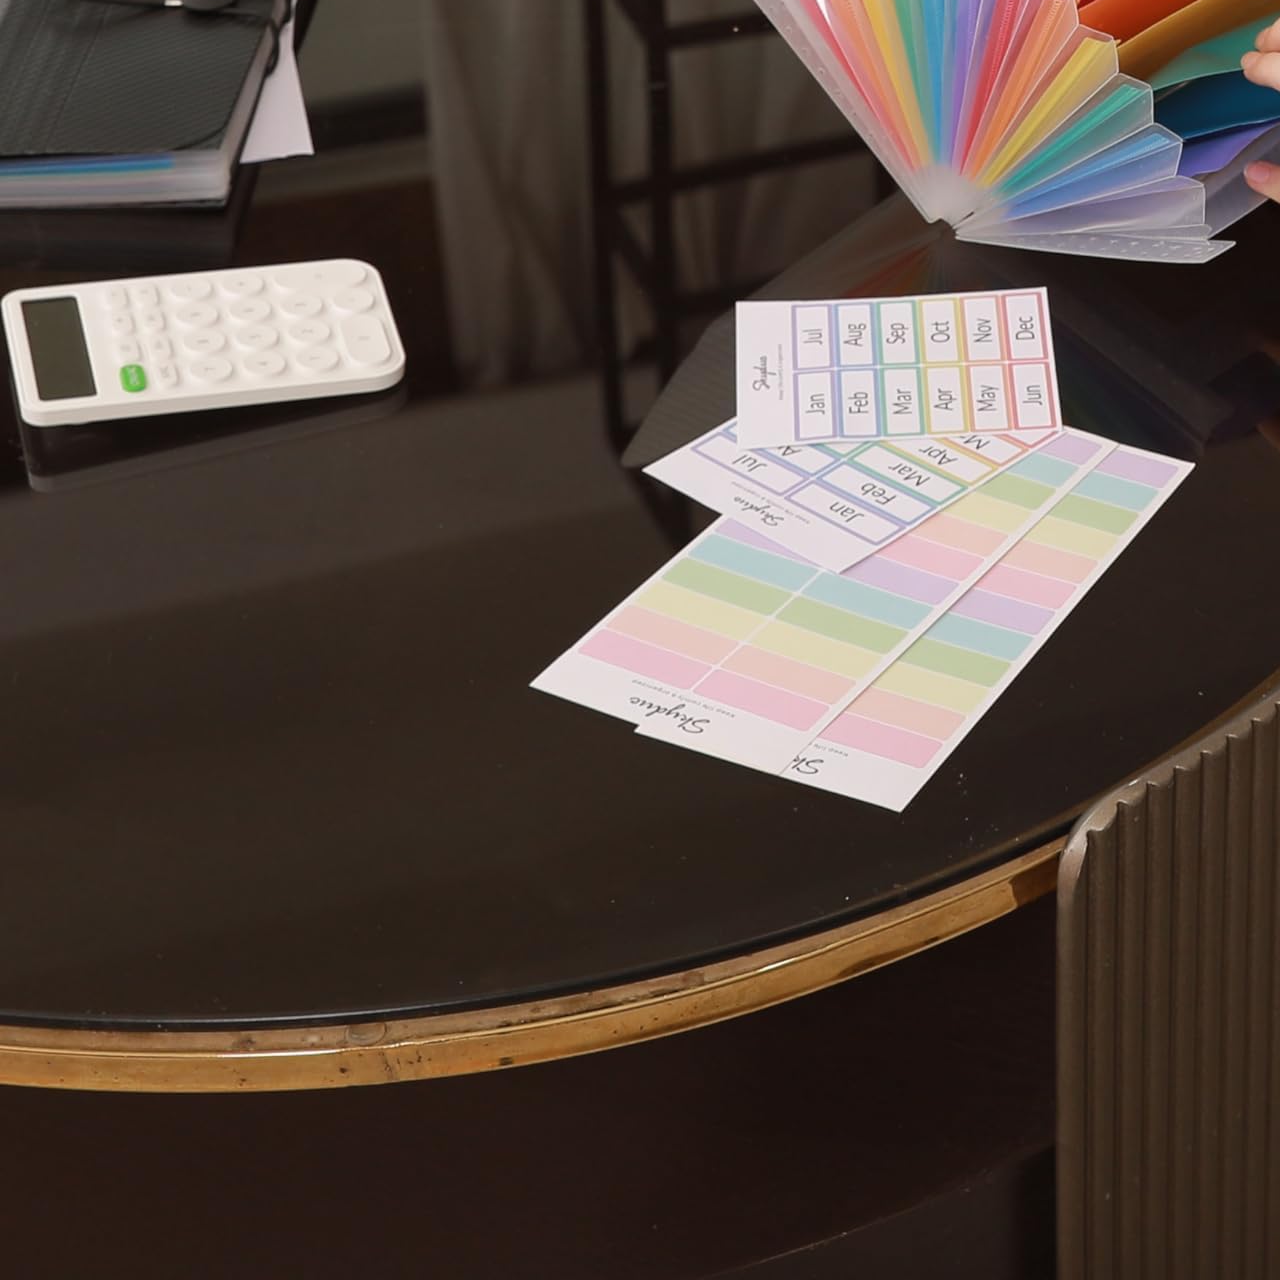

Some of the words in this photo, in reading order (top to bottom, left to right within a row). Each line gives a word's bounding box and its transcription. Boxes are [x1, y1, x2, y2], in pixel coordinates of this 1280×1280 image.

[802, 328, 823, 345] Jul
[843, 323, 867, 347] Aug
[886, 322, 909, 345] Sep
[930, 320, 951, 344] Oct
[973, 318, 992, 343] Nov
[1014, 316, 1035, 341] Dec
[805, 393, 826, 415] Jan
[848, 391, 869, 415] Feb
[892, 388, 913, 415] Mar
[933, 387, 957, 411] Apr
[976, 384, 999, 412] May
[1022, 384, 1043, 406] Jun
[731, 454, 768, 472] Jul
[918, 445, 959, 466] Apr
[887, 462, 931, 487] Mar
[860, 482, 897, 506] Feb
[829, 501, 865, 523] Jan
